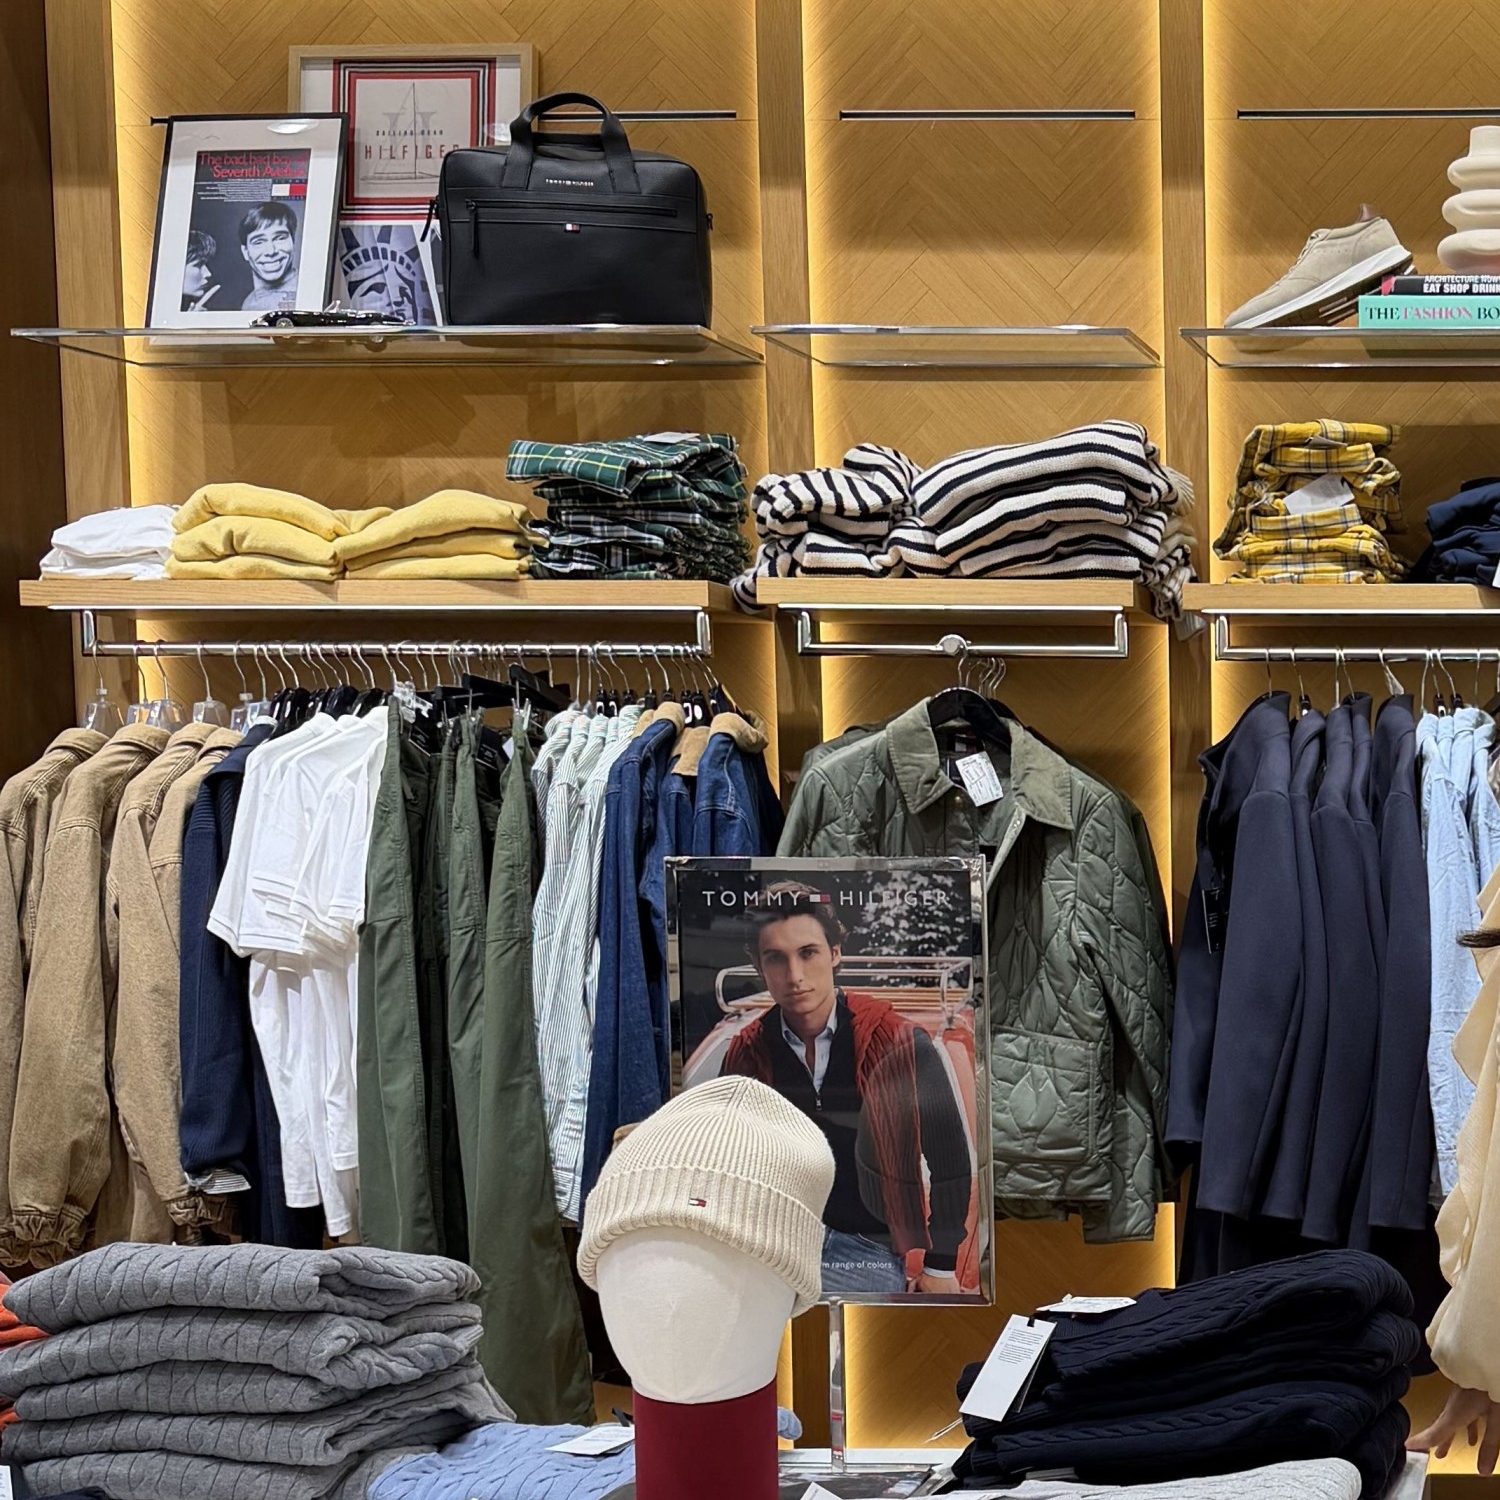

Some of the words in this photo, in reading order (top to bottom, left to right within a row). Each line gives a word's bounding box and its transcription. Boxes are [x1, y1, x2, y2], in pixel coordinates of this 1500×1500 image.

[1423, 283, 1441, 293] EAT
[1443, 283, 1470, 293] SHOP
[1365, 307, 1400, 320] THE
[1403, 306, 1472, 320] FASHION
[702, 890, 801, 906] TOMMY
[840, 890, 950, 906] HILFIGER
[831, 1261, 855, 1271] range
[856, 1260, 865, 1269] of
